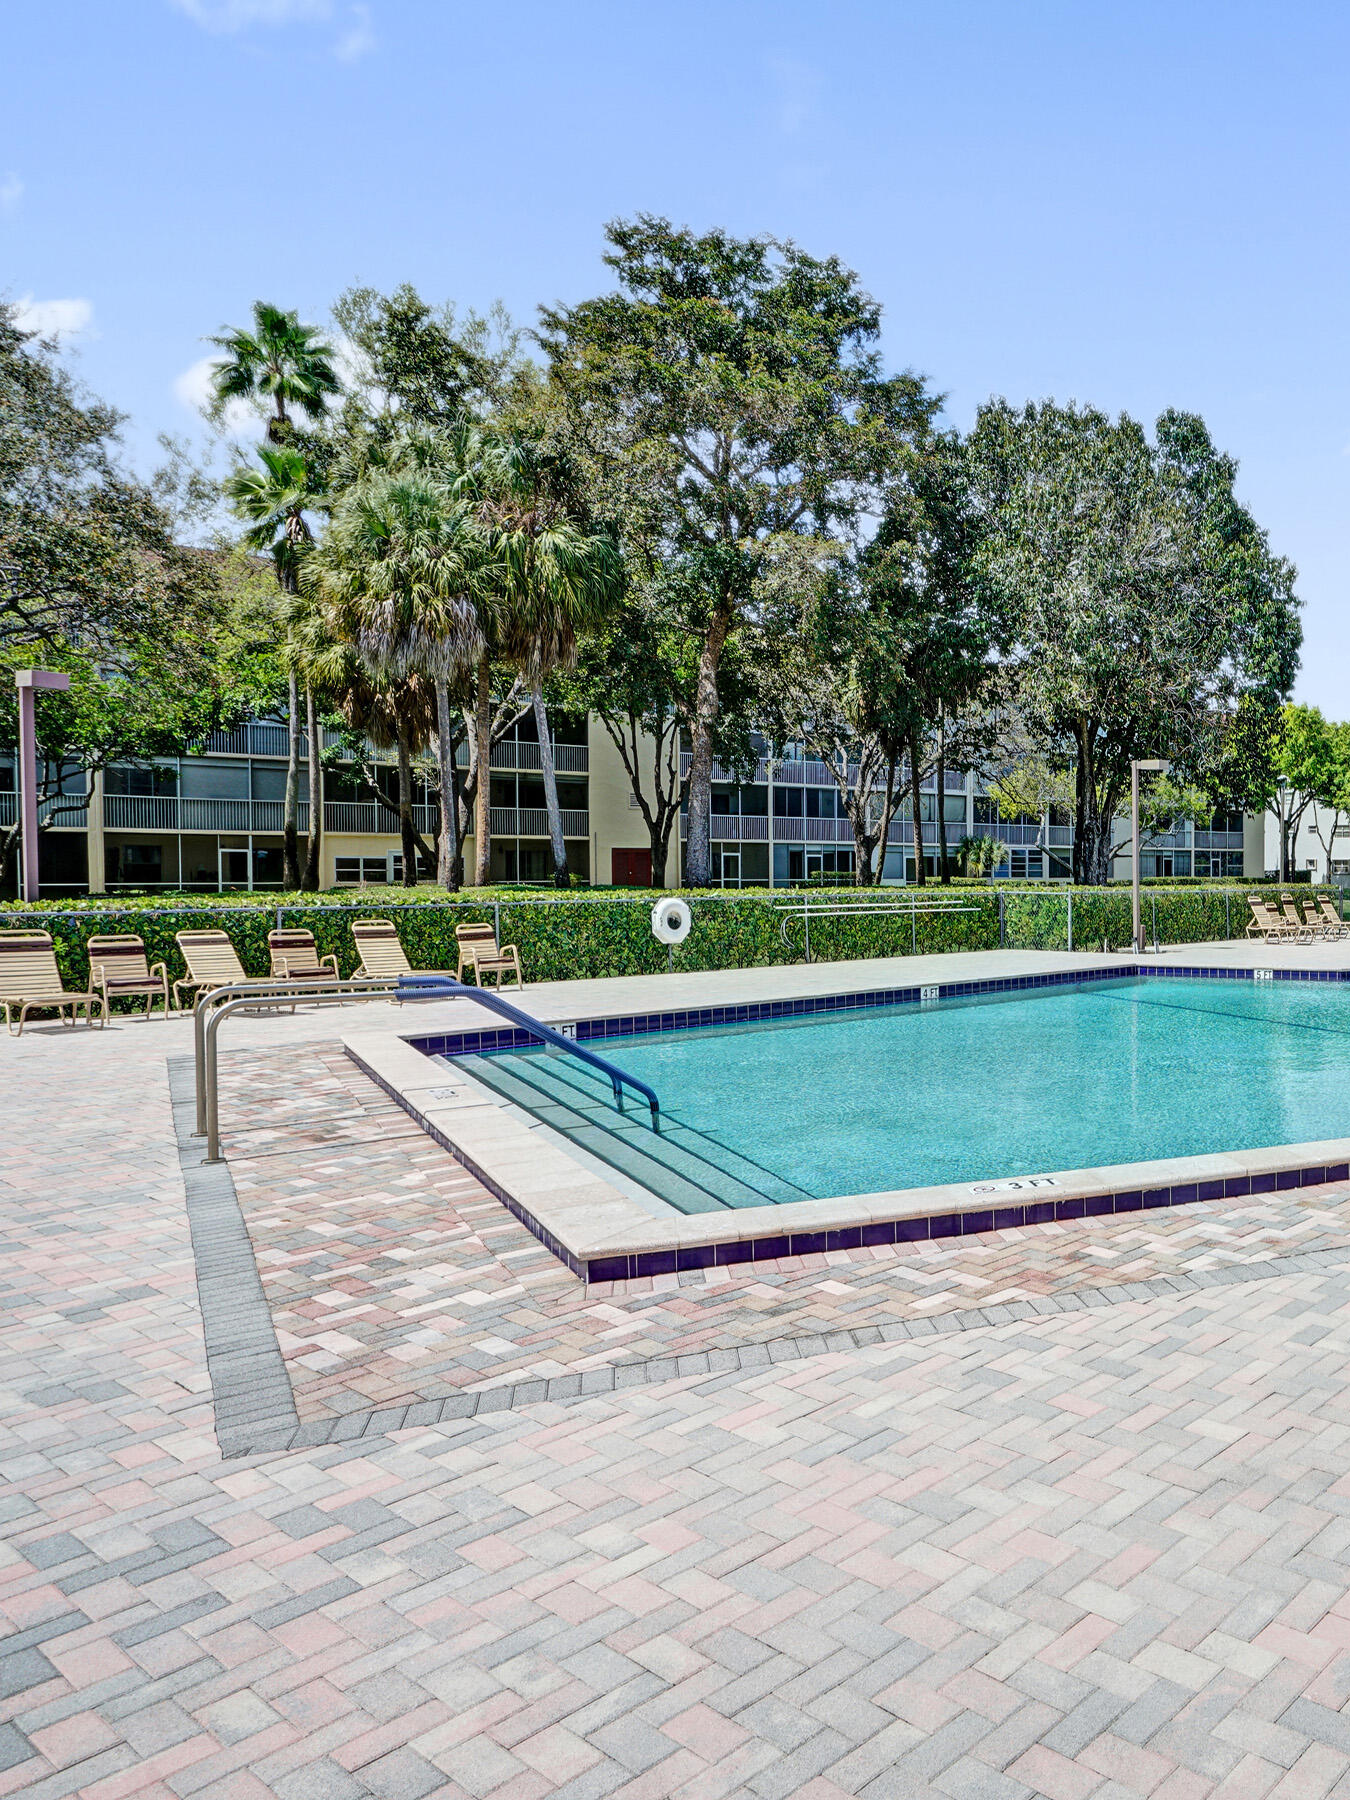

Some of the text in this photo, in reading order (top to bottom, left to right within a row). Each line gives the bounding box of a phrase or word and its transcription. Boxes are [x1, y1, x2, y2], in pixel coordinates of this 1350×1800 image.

[1256, 970, 1272, 979] 5 FT
[923, 987, 938, 998] 4 FT
[1008, 1178, 1055, 1190] 3 FT
